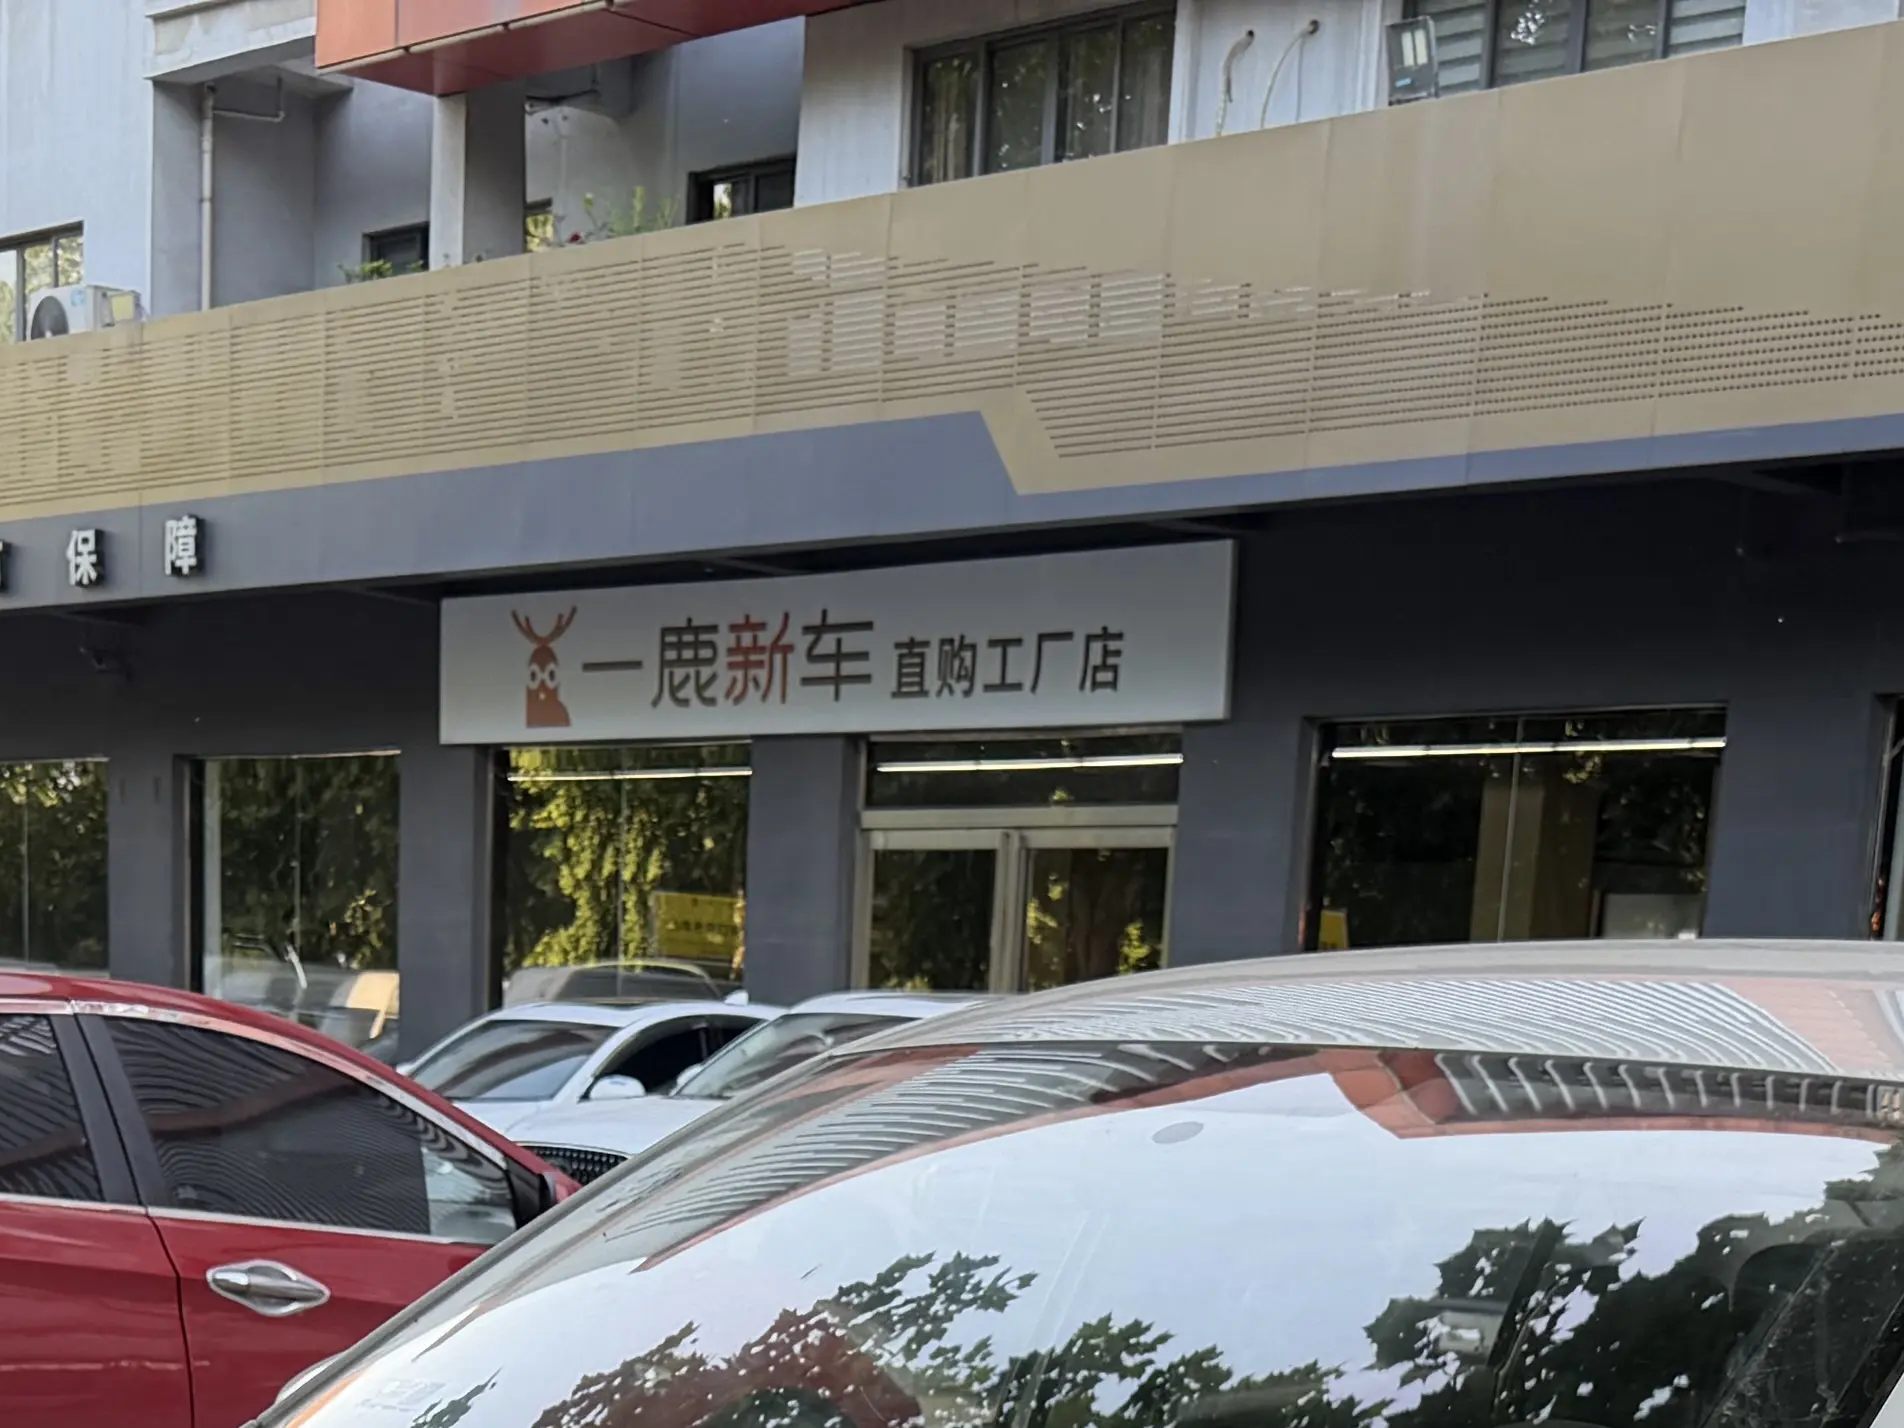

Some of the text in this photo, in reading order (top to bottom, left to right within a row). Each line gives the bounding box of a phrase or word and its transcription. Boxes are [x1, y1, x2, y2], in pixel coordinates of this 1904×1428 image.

[582, 608, 1125, 709] 一鹿新车 直购工厂店
